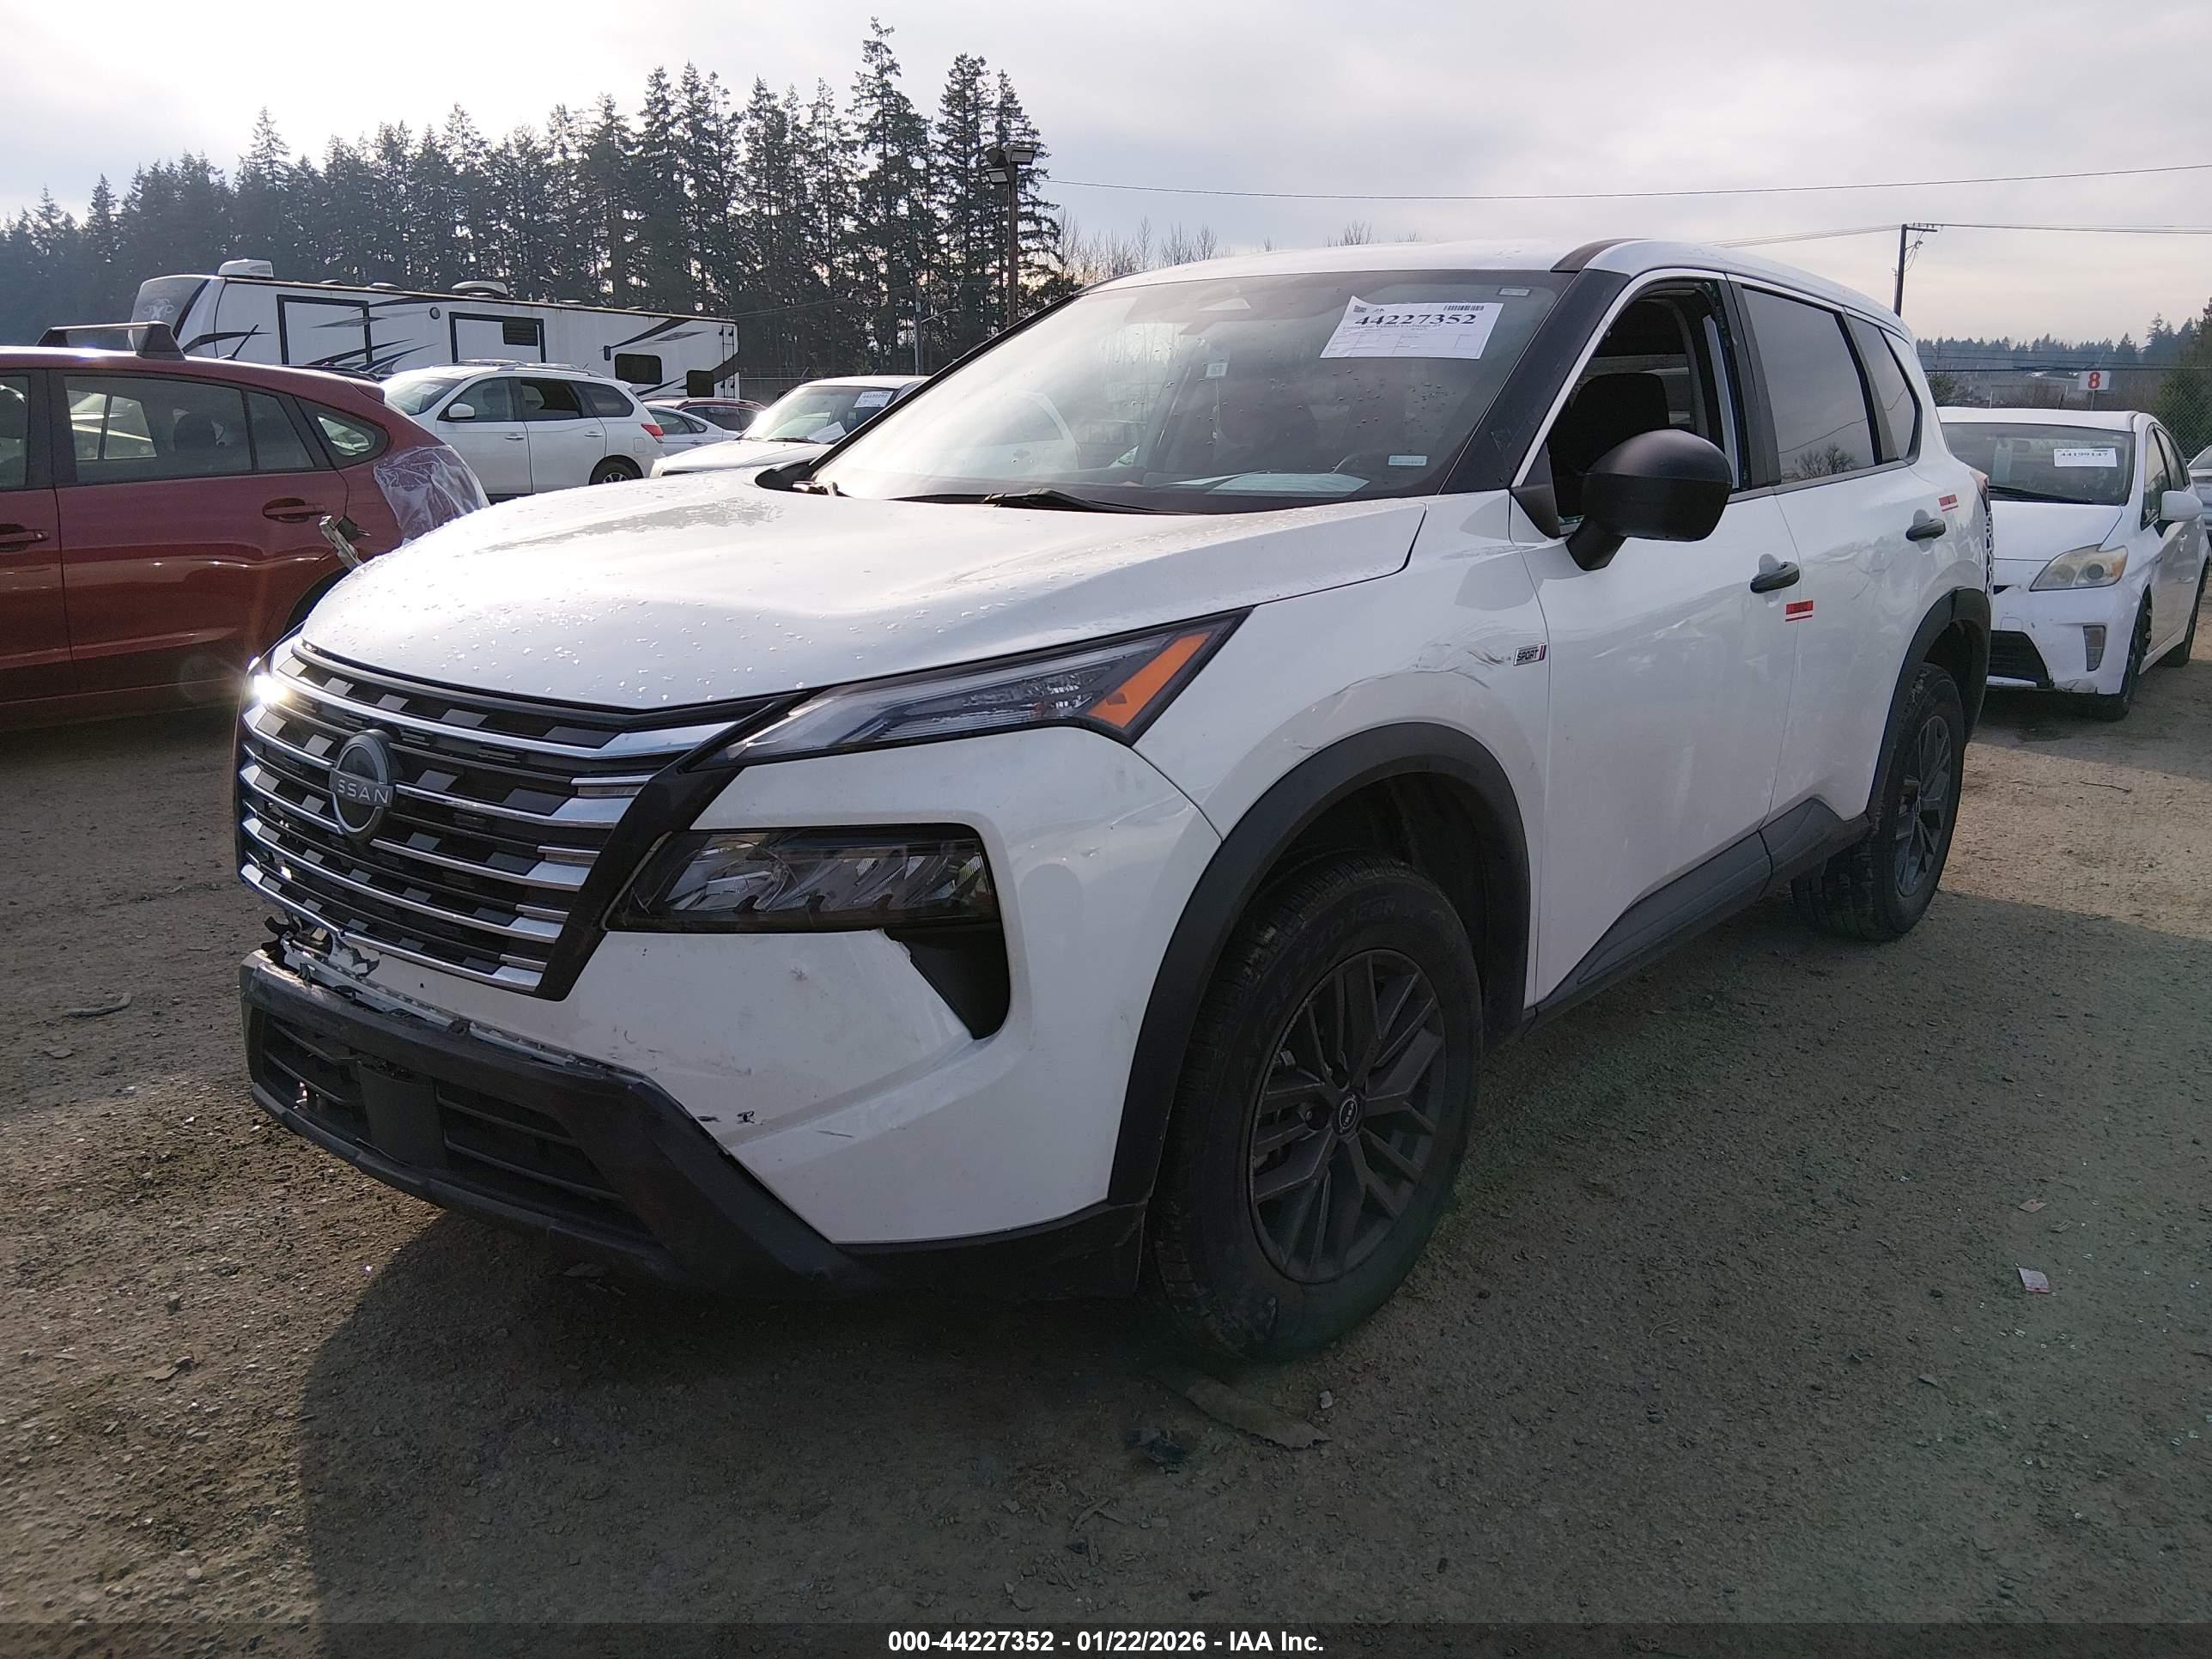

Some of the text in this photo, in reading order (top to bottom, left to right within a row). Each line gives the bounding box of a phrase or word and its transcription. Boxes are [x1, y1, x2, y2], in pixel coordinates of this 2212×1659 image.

[1355, 313, 1476, 325] 44227352
[2088, 372, 2100, 389] 8
[1516, 649, 1539, 661] SPORT
[331, 778, 389, 804] SSAN
